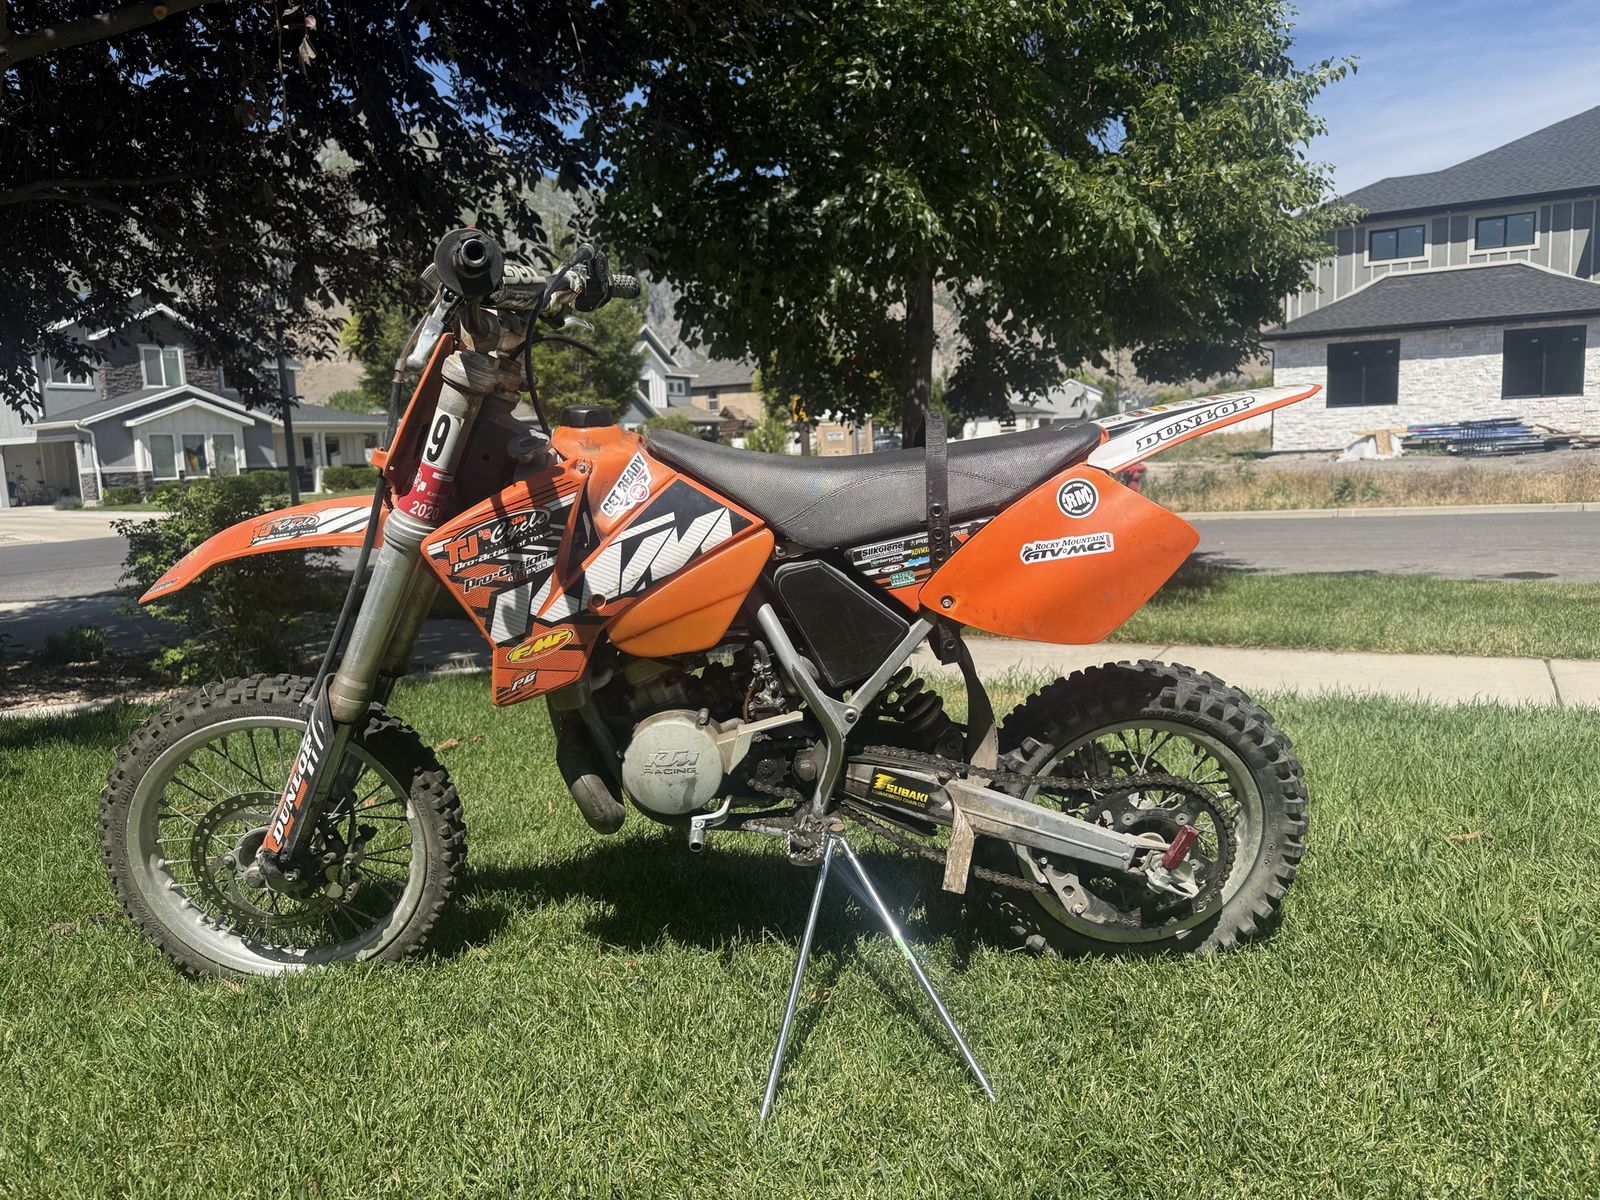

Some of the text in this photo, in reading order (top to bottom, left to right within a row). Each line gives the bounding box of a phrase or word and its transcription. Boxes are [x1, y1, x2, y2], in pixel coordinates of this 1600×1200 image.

[426, 414, 451, 462] 9
[1136, 396, 1255, 453] DUNLOP
[603, 455, 645, 515] GET READY
[409, 500, 440, 521] 2020
[490, 511, 547, 544] Cycle
[1062, 534, 1105, 547] MOUNTAIN
[517, 538, 527, 548] of
[861, 542, 904, 558] Silkolene
[509, 629, 572, 662] FMF
[643, 767, 697, 775] RACING
[644, 749, 700, 768] KTM
[273, 733, 312, 846] DUNLOP
[873, 773, 929, 803] TSUBAKI
